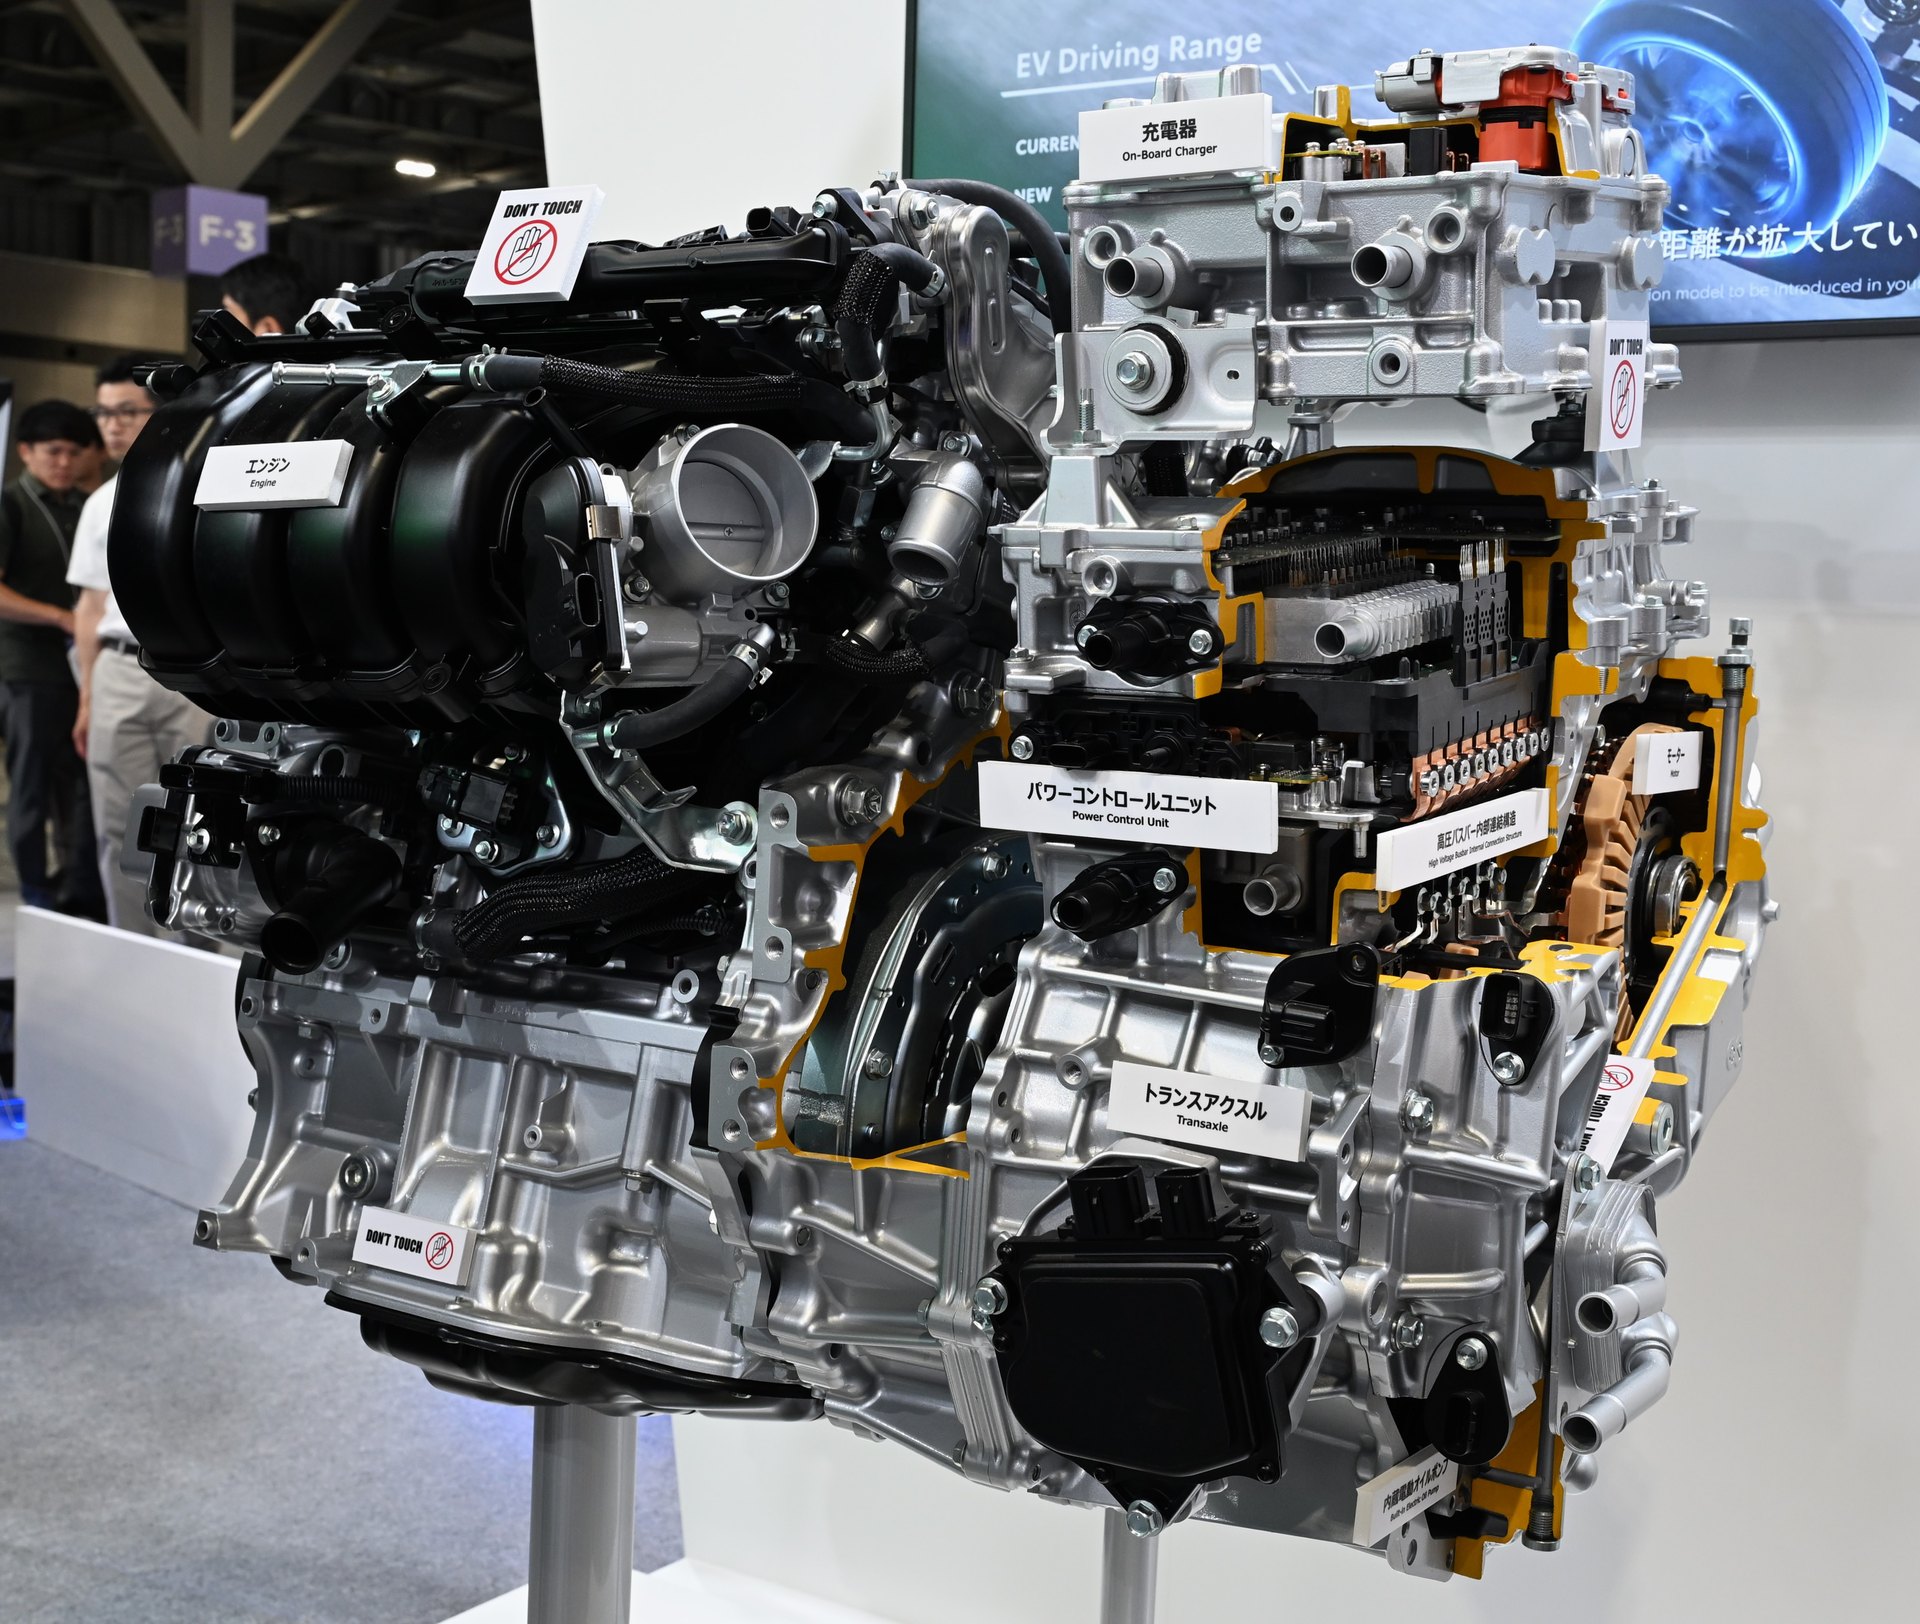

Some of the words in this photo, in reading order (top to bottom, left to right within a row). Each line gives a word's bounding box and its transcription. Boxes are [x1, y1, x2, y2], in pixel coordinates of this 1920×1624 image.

[1016, 51, 1050, 78] EV
[1058, 41, 1159, 71] Driving
[1170, 32, 1262, 62] Range
[1142, 118, 1197, 142] 充電器
[1122, 147, 1172, 161] On-Board
[1175, 144, 1217, 157] Charger
[503, 203, 539, 218] DON'T
[542, 200, 583, 215] TOUCH
[199, 214, 256, 252] F-3
[1660, 221, 1918, 261] 距離が拡大してい
[1676, 284, 1724, 300] model
[1730, 284, 1744, 298] to
[1750, 281, 1769, 297] be
[1774, 277, 1862, 296] introduced
[1867, 278, 1882, 292] in
[1626, 339, 1643, 355] TOUCH
[245, 458, 290, 473] エンジン
[250, 479, 276, 489] Engine
[1667, 747, 1685, 763] モーター
[1027, 782, 1217, 815] パワーコントロールユニット
[1072, 811, 1104, 822] Power
[1106, 813, 1144, 825] Control
[1147, 817, 1170, 828] Unit
[1437, 810, 1516, 850] 高圧バスバー内部連結構造
[1428, 859, 1438, 868] High
[1439, 852, 1454, 863] Voltage
[1455, 849, 1468, 858] Busbar
[1469, 843, 1484, 854] Internal
[1485, 836, 1505, 848] Connection
[1506, 831, 1522, 841] Structure
[1145, 1083, 1268, 1121] トランスアクスル
[1176, 1114, 1229, 1132] Transaxle
[366, 1229, 391, 1246] DON'T
[394, 1235, 423, 1254] TOUCH
[1406, 1496, 1420, 1511] Electric
